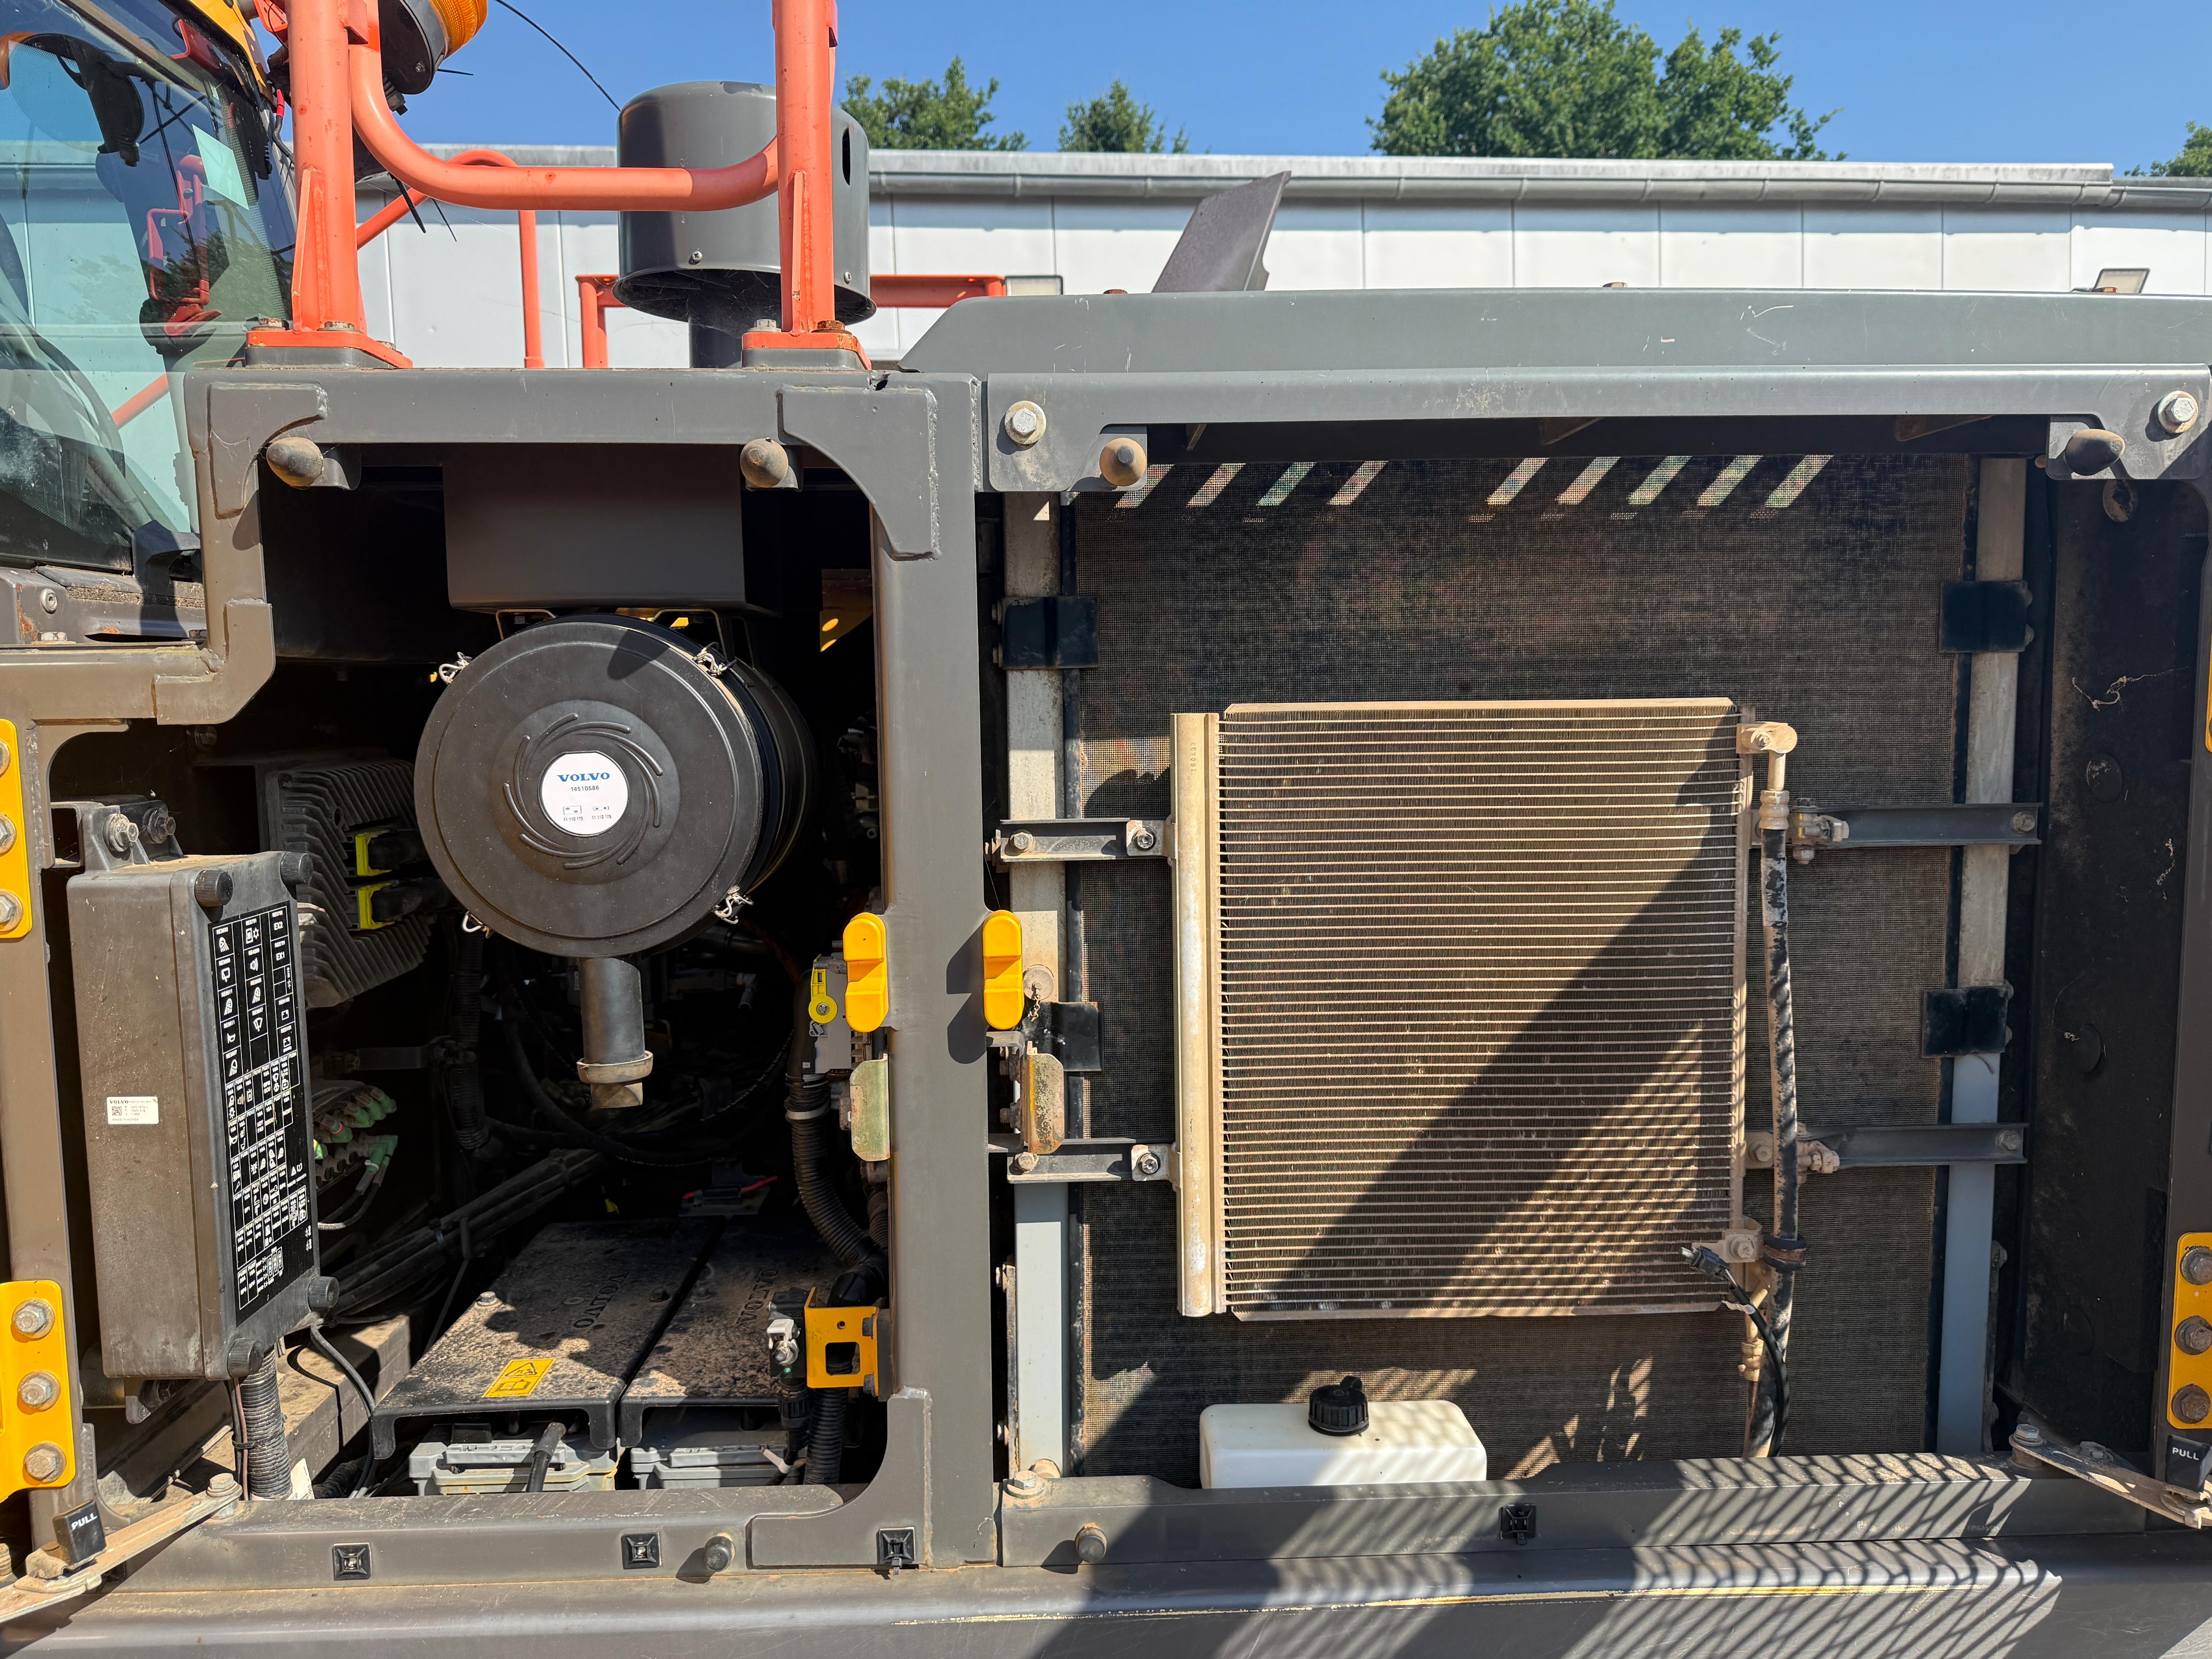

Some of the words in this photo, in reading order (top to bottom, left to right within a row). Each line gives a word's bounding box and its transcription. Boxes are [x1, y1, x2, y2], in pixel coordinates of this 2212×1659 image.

[556, 772, 610, 782] VOLVO
[274, 921, 283, 930] EX2
[276, 951, 285, 960] EX1
[573, 1271, 630, 1328] VOLVO
[736, 1268, 780, 1324] VOLVO
[2172, 1447, 2199, 1461] PULL
[71, 1513, 98, 1531] PULL
